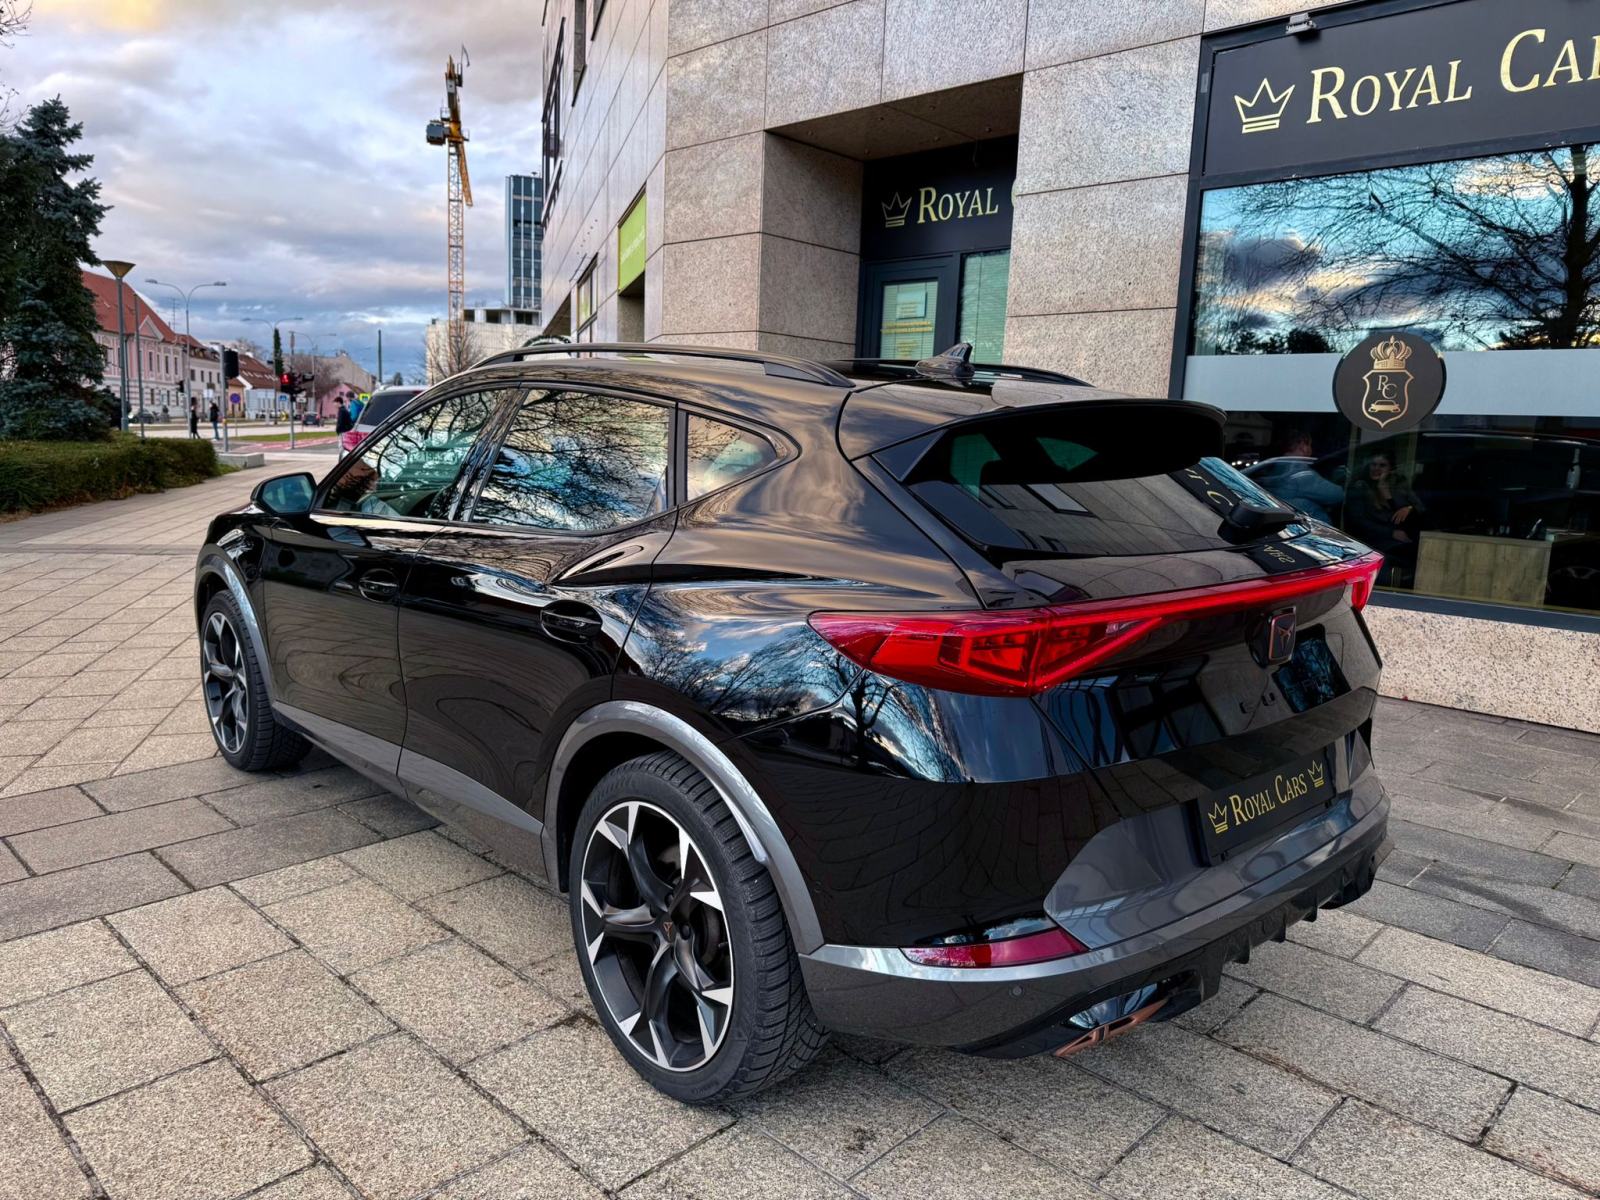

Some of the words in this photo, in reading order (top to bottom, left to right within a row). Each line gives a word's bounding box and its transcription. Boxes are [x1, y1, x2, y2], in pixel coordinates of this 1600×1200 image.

[1306, 59, 1473, 124] ROYAL
[917, 186, 999, 224] ROYAL
[1229, 789, 1276, 826] ROYAL
[1274, 773, 1308, 804] CARS
